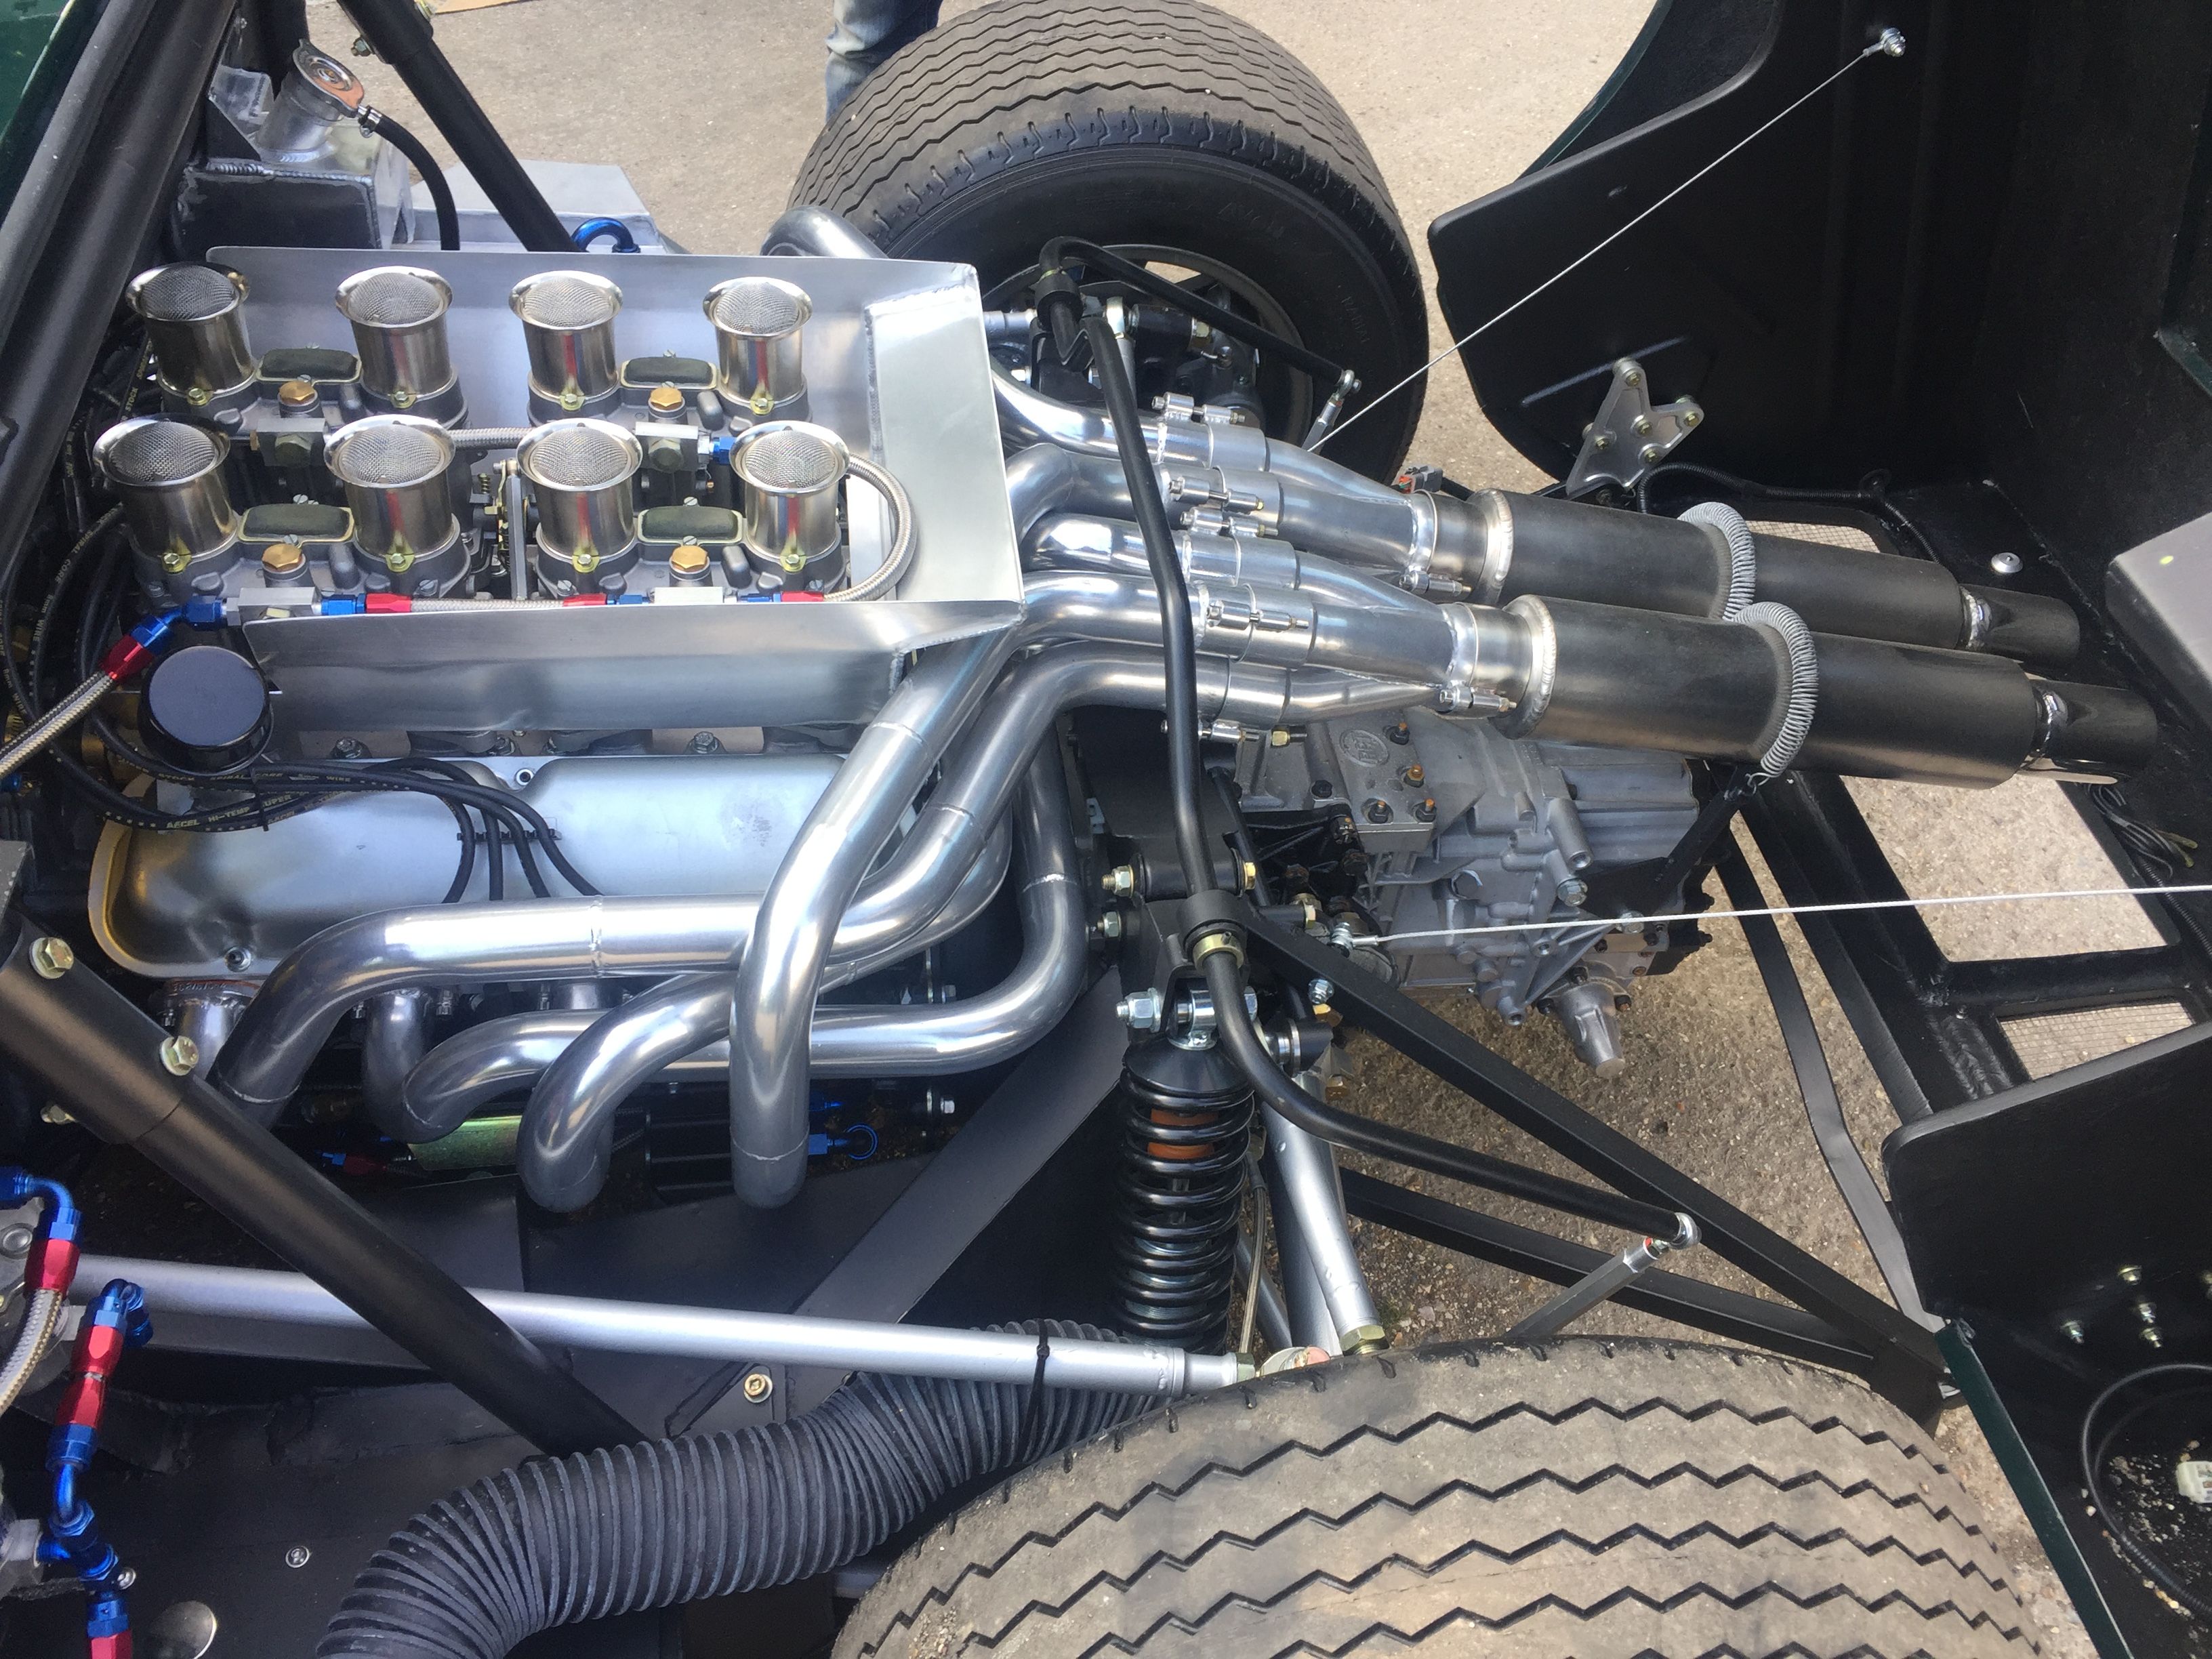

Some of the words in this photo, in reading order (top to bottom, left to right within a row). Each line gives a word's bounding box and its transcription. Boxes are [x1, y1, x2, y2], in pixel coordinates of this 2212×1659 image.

[125, 387, 138, 411] STOCK
[71, 530, 94, 554] SPIRAL
[55, 559, 70, 584] CORE
[33, 619, 45, 641] WIRE
[166, 819, 200, 829] ACCEL
[208, 806, 250, 822] HI-TEMP
